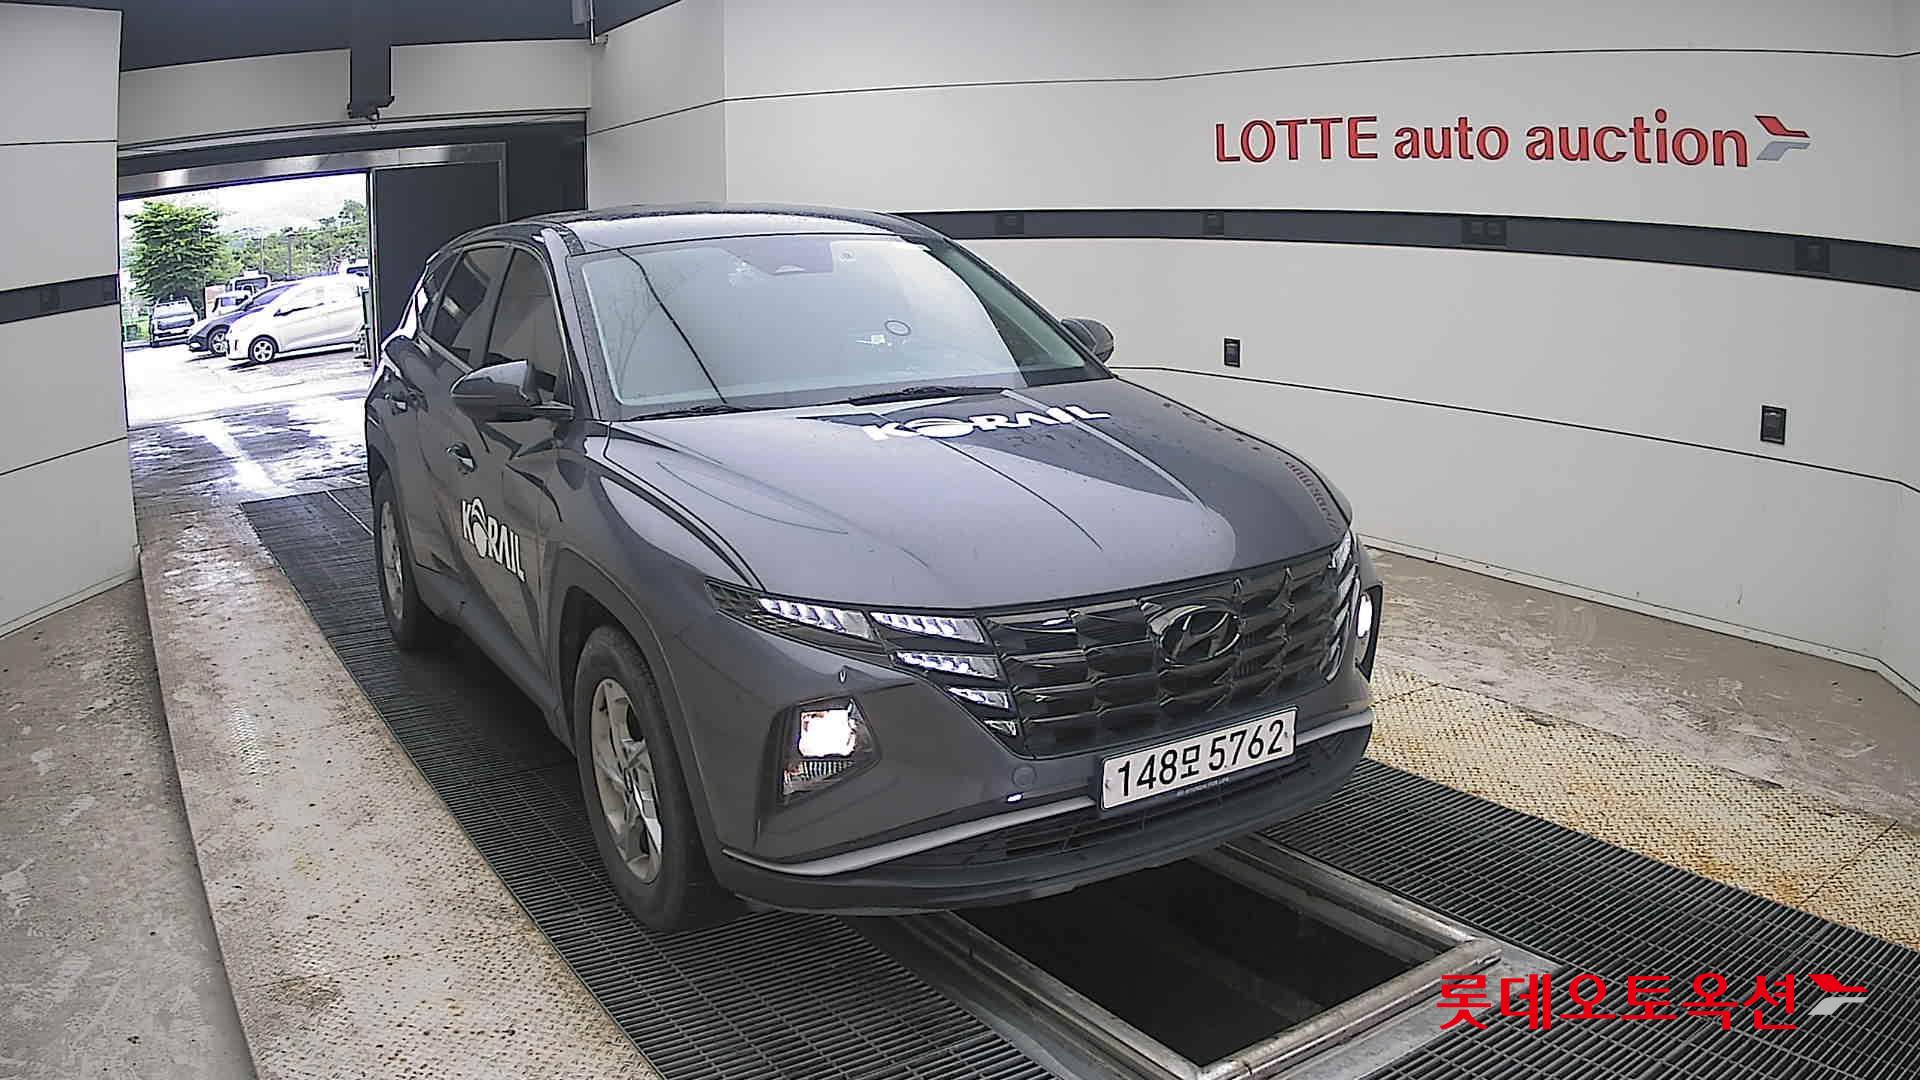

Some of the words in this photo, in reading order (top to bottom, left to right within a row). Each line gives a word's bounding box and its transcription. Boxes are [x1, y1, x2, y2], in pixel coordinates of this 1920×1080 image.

[1215, 116, 1377, 162] LOTTE
[1393, 115, 1508, 159] auto
[1524, 108, 1748, 167] auction
[862, 405, 1111, 441] KORAIL
[462, 498, 525, 583] KORAIL
[1118, 745, 1200, 797] 148모
[1209, 719, 1284, 771] 5762
